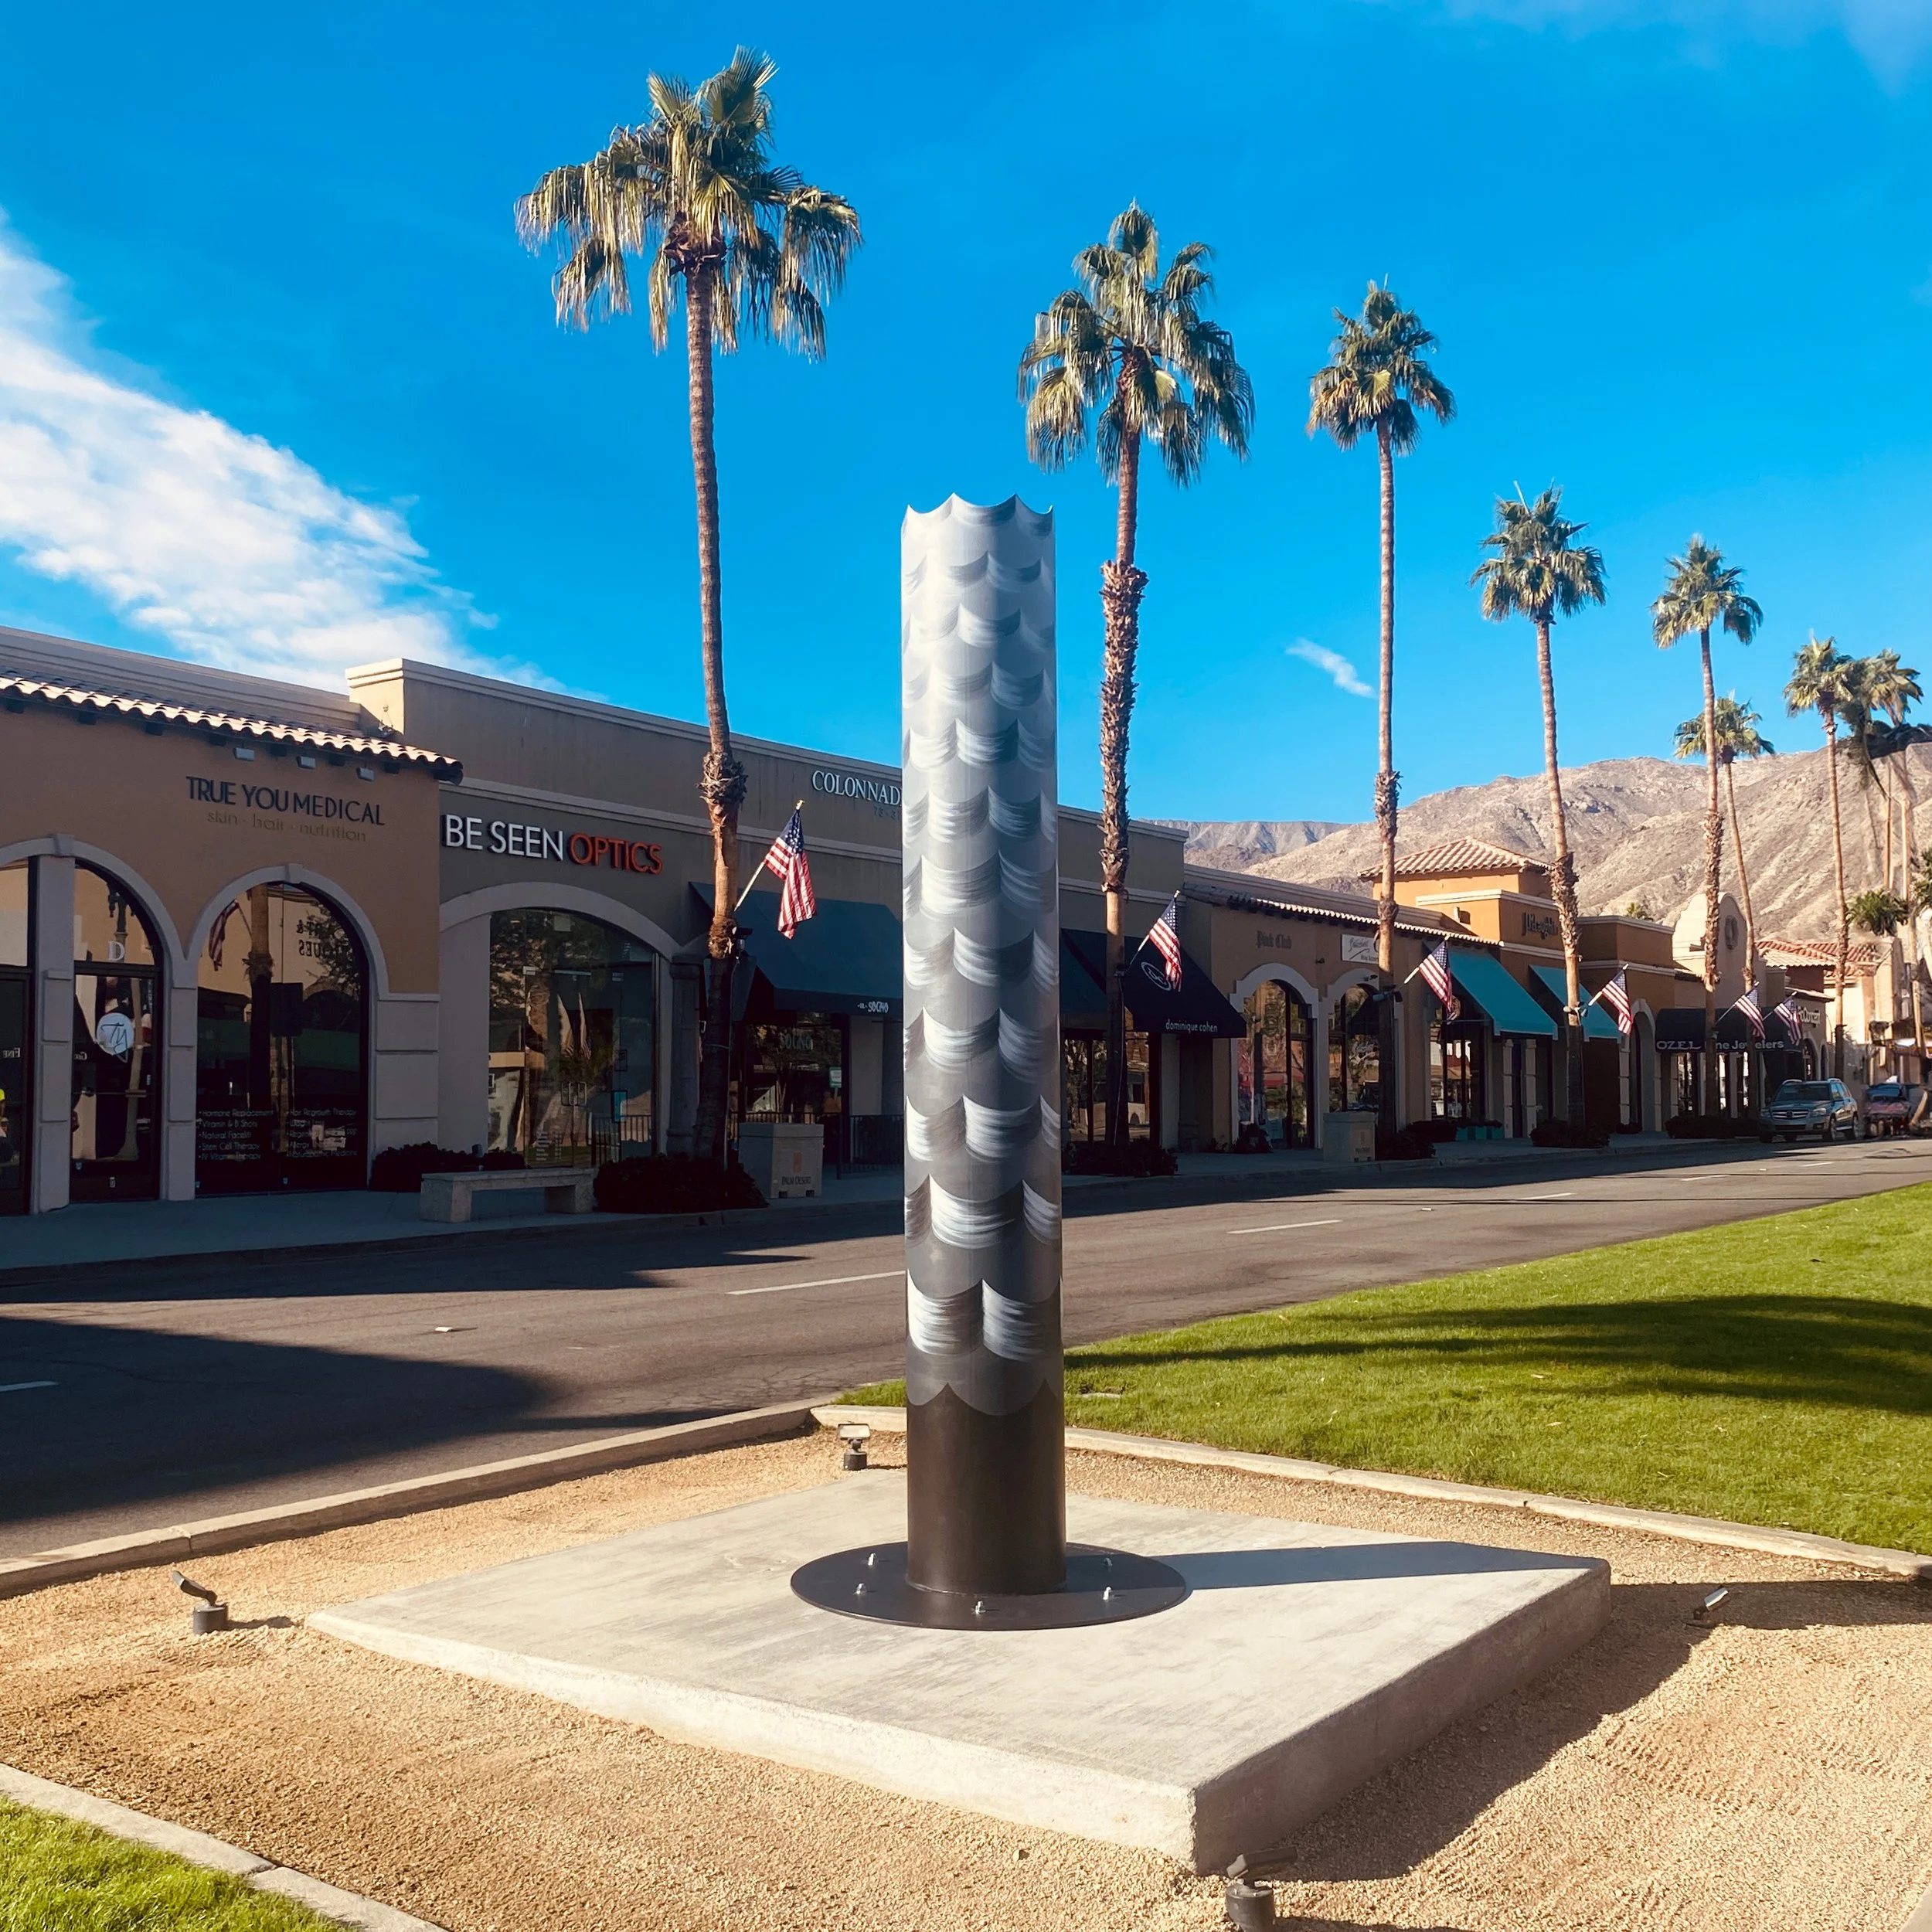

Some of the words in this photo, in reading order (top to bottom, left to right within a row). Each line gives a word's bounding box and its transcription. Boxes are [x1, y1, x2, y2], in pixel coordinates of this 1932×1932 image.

[186, 776, 236, 805] TRUE
[241, 784, 289, 812] YOU
[293, 791, 385, 826] MEDICAL
[811, 770, 902, 807] COLONNAD
[207, 810, 238, 825] skin
[253, 813, 284, 832] hair
[299, 823, 366, 842] nutrition
[443, 814, 484, 851] BE
[488, 820, 564, 861] SEEN
[567, 832, 664, 875] OPTICS
[108, 940, 125, 961] D
[1165, 1019, 1198, 1034] dominique
[1199, 1021, 1218, 1032] cohen
[1656, 1039, 1702, 1050] OZEL
[1731, 1039, 1784, 1050] Jeelers
